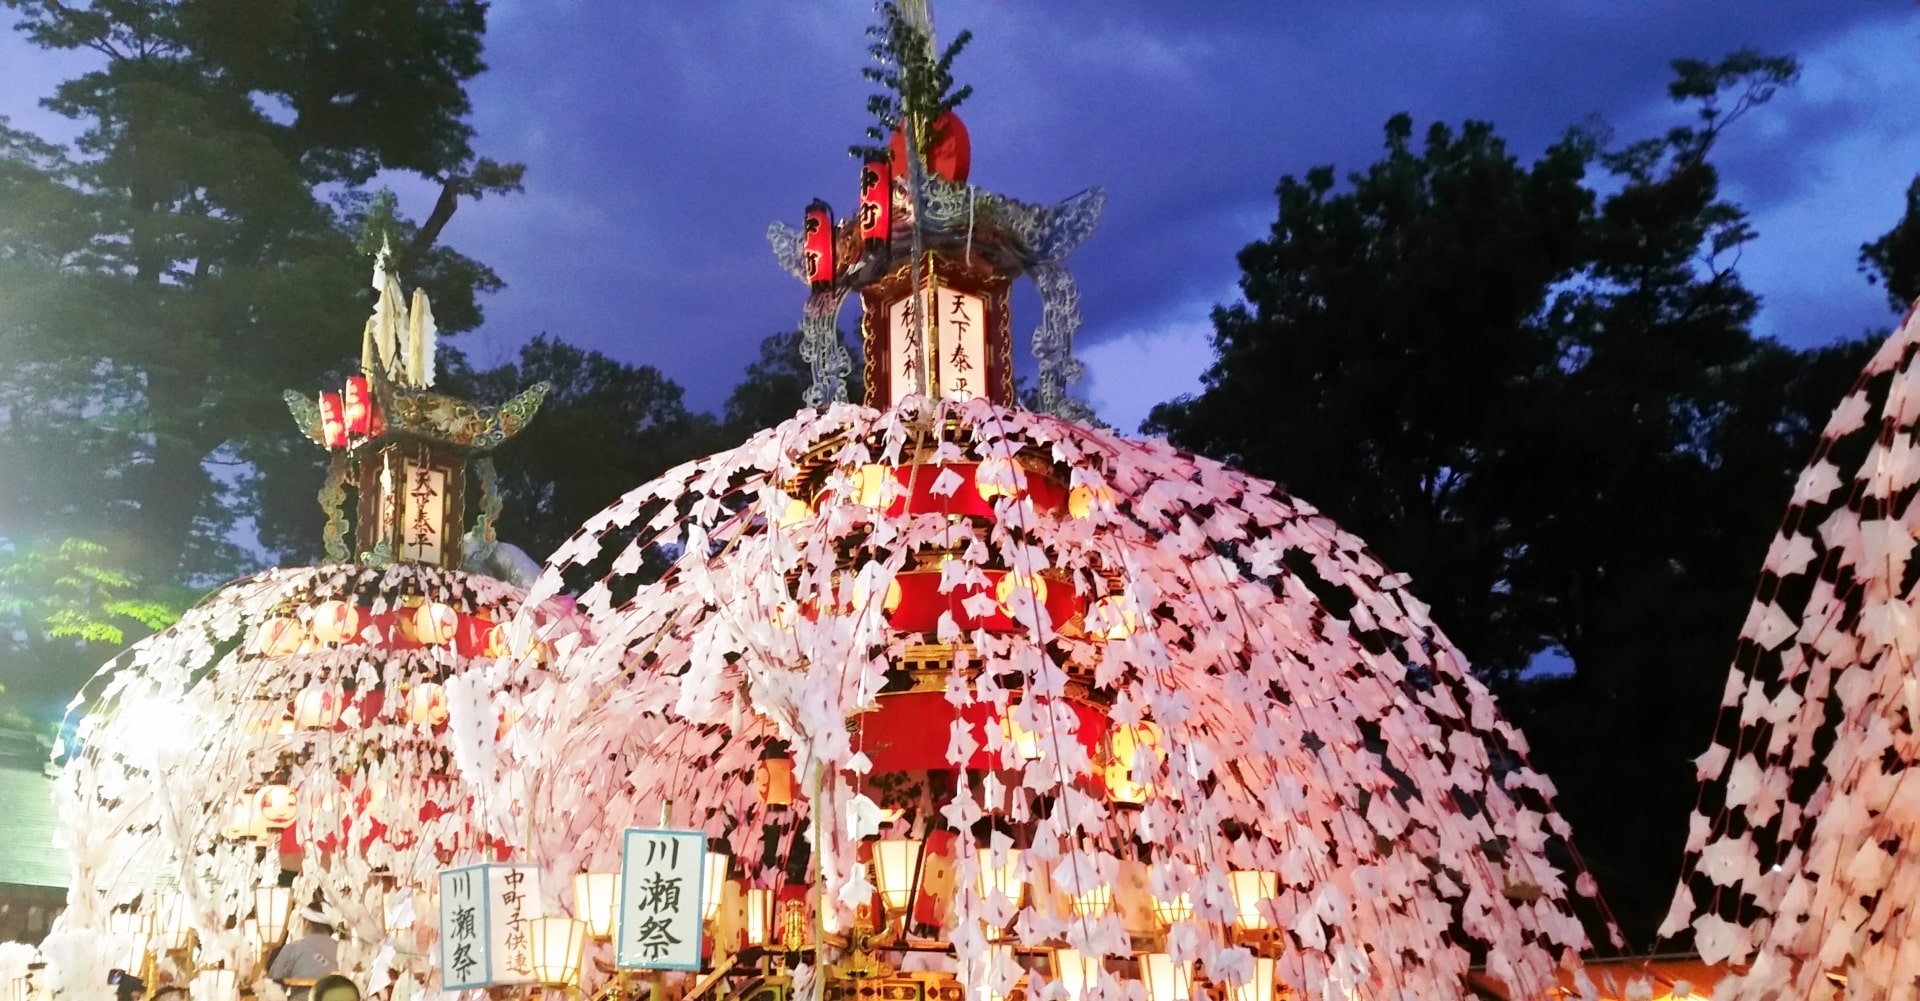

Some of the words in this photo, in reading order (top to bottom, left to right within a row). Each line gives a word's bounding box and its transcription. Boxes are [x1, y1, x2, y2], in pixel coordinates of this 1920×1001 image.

[901, 299, 920, 388] 秩父神
[949, 294, 973, 402] 天下泰平
[408, 471, 438, 558] 天下泰平
[450, 871, 477, 983] 川瀬祭
[501, 868, 531, 976] 中町子供連
[637, 836, 683, 961] 川瀬祭
